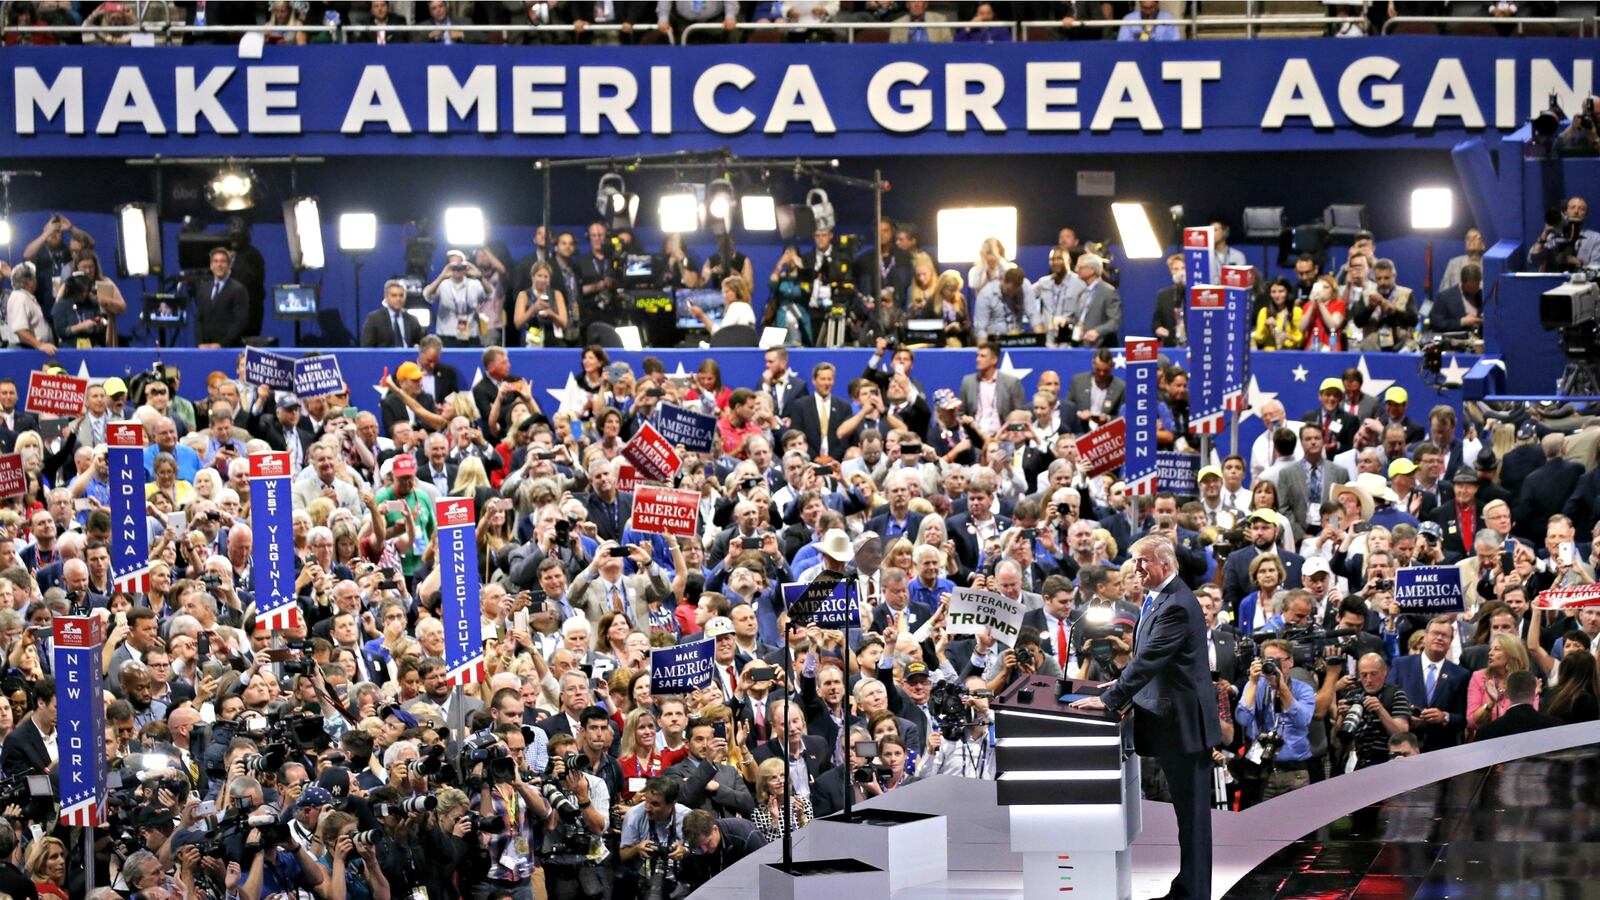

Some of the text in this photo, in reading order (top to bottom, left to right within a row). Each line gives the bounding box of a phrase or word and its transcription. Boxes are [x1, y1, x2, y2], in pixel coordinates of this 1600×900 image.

[14, 56, 1593, 134] MAKE AMERICA GREAT AGAIN
[1226, 291, 1236, 383] LOUISIANA
[260, 357, 278, 367] MAKE
[304, 362, 322, 371] MAKE
[1203, 311, 1213, 405] MISSISSIPPI
[246, 361, 294, 381] AMERICA
[249, 372, 290, 387] SAFE AGAIN
[41, 379, 77, 391] MAKE OUR
[296, 379, 339, 393] SAFE AGAIN
[31, 386, 84, 403] BORDERS
[33, 398, 79, 411] SAFE AGAIN
[1136, 368, 1149, 457] OREGON
[676, 413, 697, 425] MAKE
[660, 417, 712, 441] AMERICA
[662, 429, 707, 448] SAFE AGAIN
[1091, 431, 1111, 445] MAKE
[629, 446, 647, 464] SAFE
[633, 436, 675, 478] AMERICA
[653, 440, 670, 458] MAKE
[1083, 436, 1125, 463] MERIC
[1094, 456, 1109, 467] AFE
[1175, 460, 1192, 469] OUR
[1169, 479, 1195, 489] AGAIN
[121, 454, 137, 556] INDIANA
[265, 480, 278, 516] WEST
[655, 494, 679, 504] MAKE
[634, 502, 696, 520] AMERICA
[638, 515, 690, 529] SAFE AGAIN
[268, 525, 281, 597] VIRGINIA
[1415, 574, 1438, 583] MAKE
[452, 529, 469, 653] CONNECTICUT
[808, 588, 834, 598] MAKE
[1396, 583, 1460, 598] AMERICA
[788, 598, 858, 613] AMERICA
[960, 592, 1018, 615] VETERANS
[976, 605, 997, 616] FOR
[1400, 597, 1457, 608] SAFE AGAIN
[822, 612, 853, 622] AGAIN
[949, 612, 1018, 636] TRUMP
[675, 650, 698, 662] MAKE
[652, 656, 714, 679] AMERICA
[658, 671, 711, 688] SAFE AGAIN
[67, 653, 83, 783] NEW YORK
